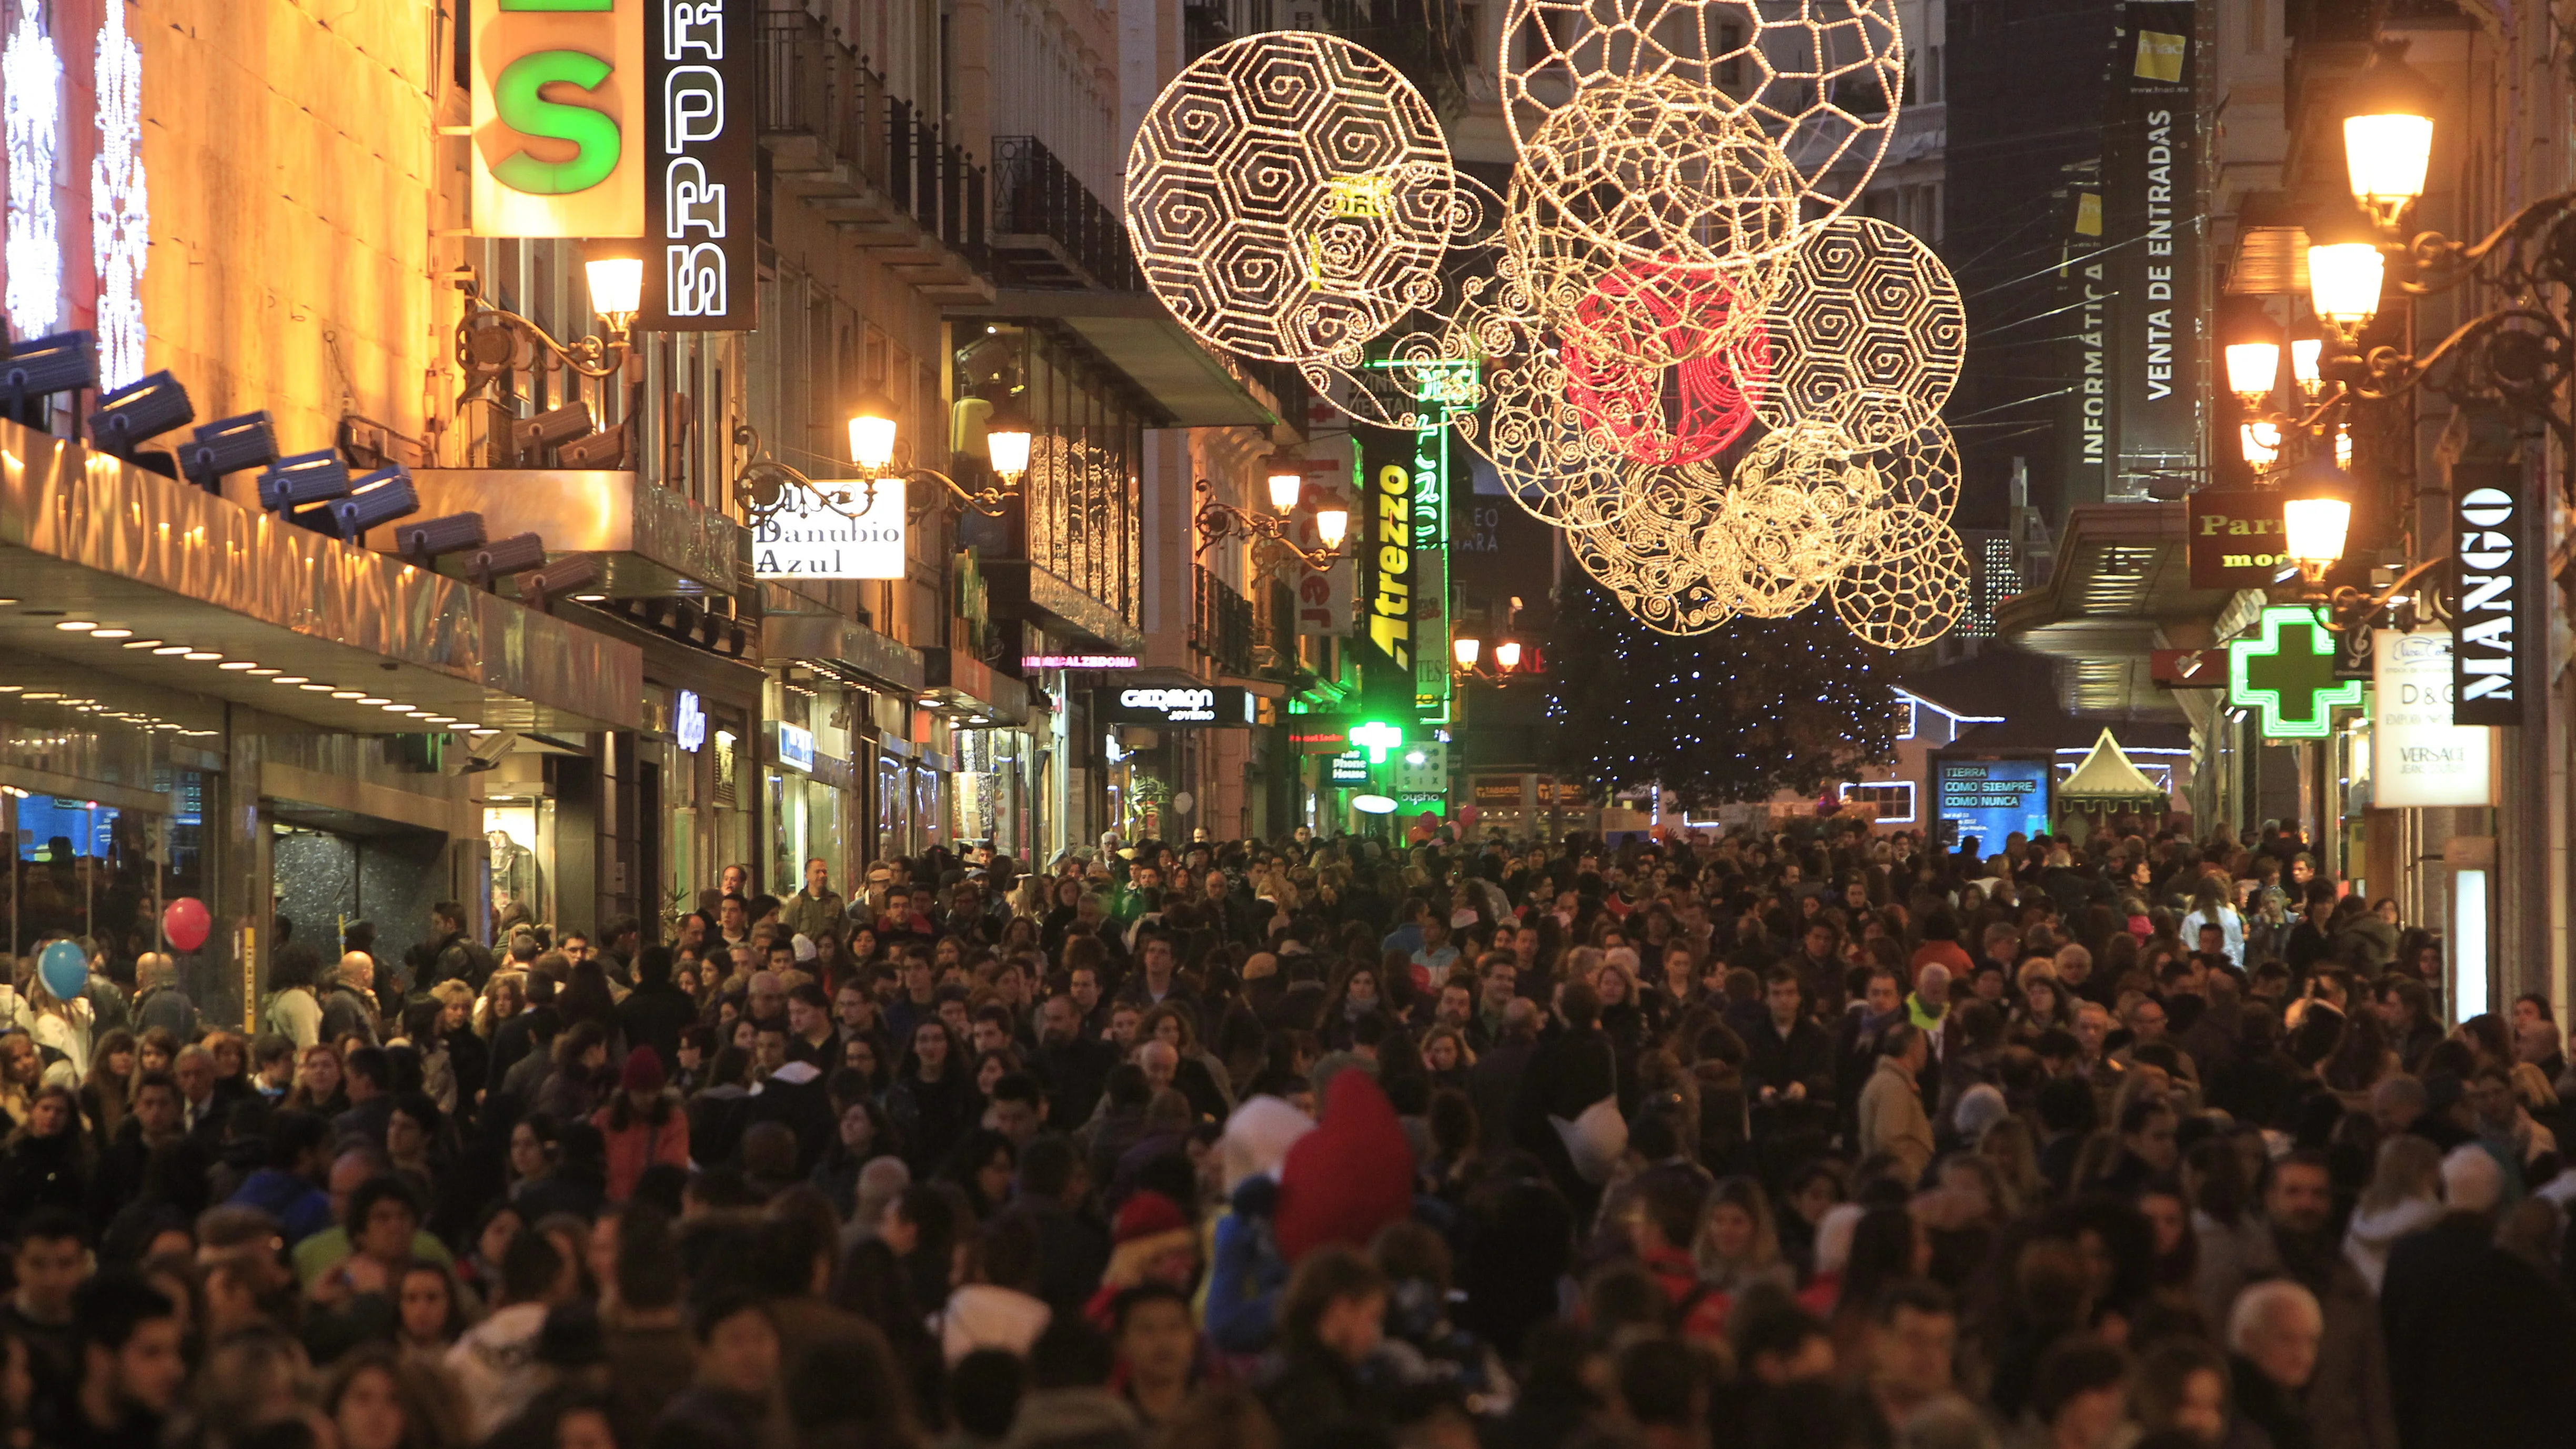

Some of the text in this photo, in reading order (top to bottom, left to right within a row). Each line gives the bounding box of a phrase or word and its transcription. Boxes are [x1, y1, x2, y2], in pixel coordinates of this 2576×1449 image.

[2148, 109, 2172, 401] VENTA DE ENTRADAS
[2080, 263, 2104, 464] INFORMÁTICA
[756, 518, 899, 544] Danubio
[756, 549, 843, 573] Azul
[1370, 464, 1408, 671] Atrezzo
[2461, 487, 2514, 702] MANGO
[1333, 758, 1366, 768] Phone
[1946, 768, 1987, 777] TIERRA
[1333, 769, 1366, 779] House
[1945, 781, 2036, 793] COMO SIEMPRE,
[1401, 791, 1440, 805] oysho
[1945, 796, 2019, 806] COMO NUNCA
